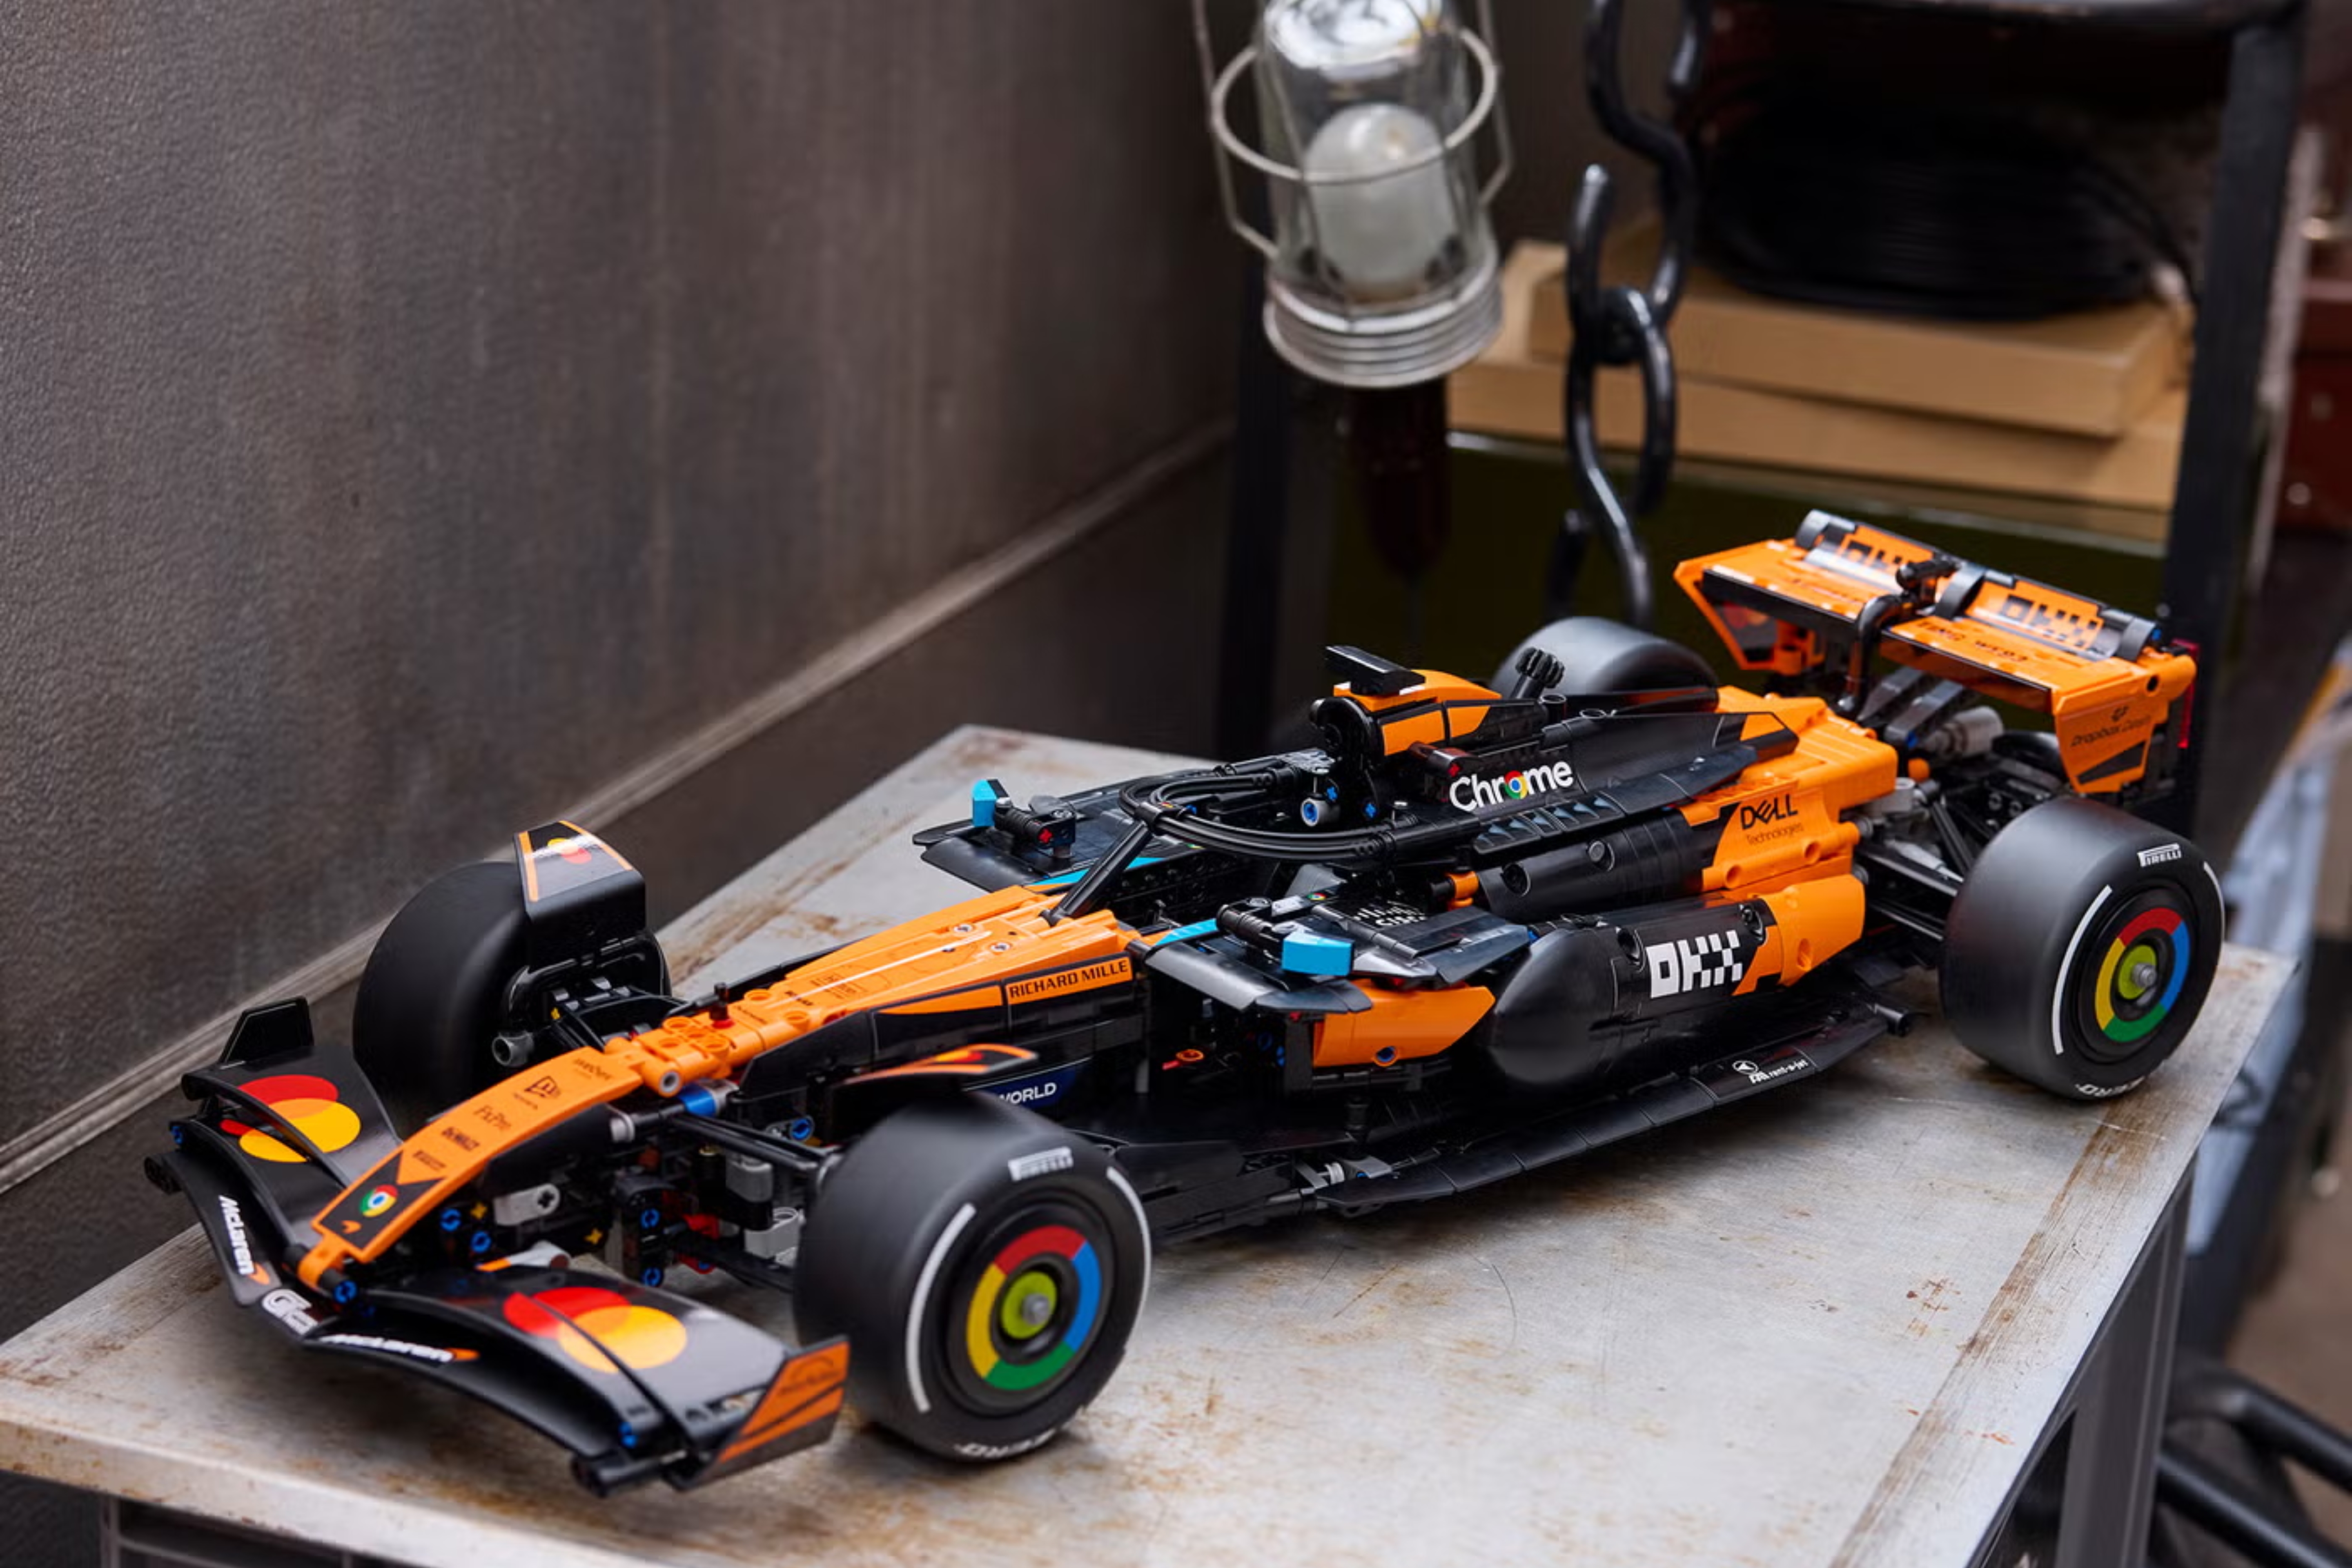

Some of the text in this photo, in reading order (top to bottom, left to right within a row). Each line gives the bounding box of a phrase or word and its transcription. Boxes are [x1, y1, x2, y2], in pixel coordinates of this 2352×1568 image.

[1450, 761, 1573, 812] Chrome
[1740, 793, 1798, 830] DELL
[1746, 822, 1805, 845] Technologies
[2136, 842, 2181, 868] PIRELLI
[1008, 960, 1128, 998] RICHARD MILLE
[1646, 929, 1743, 998] OKX
[218, 1195, 254, 1276] McLaren
[318, 1334, 453, 1363] McLaren
